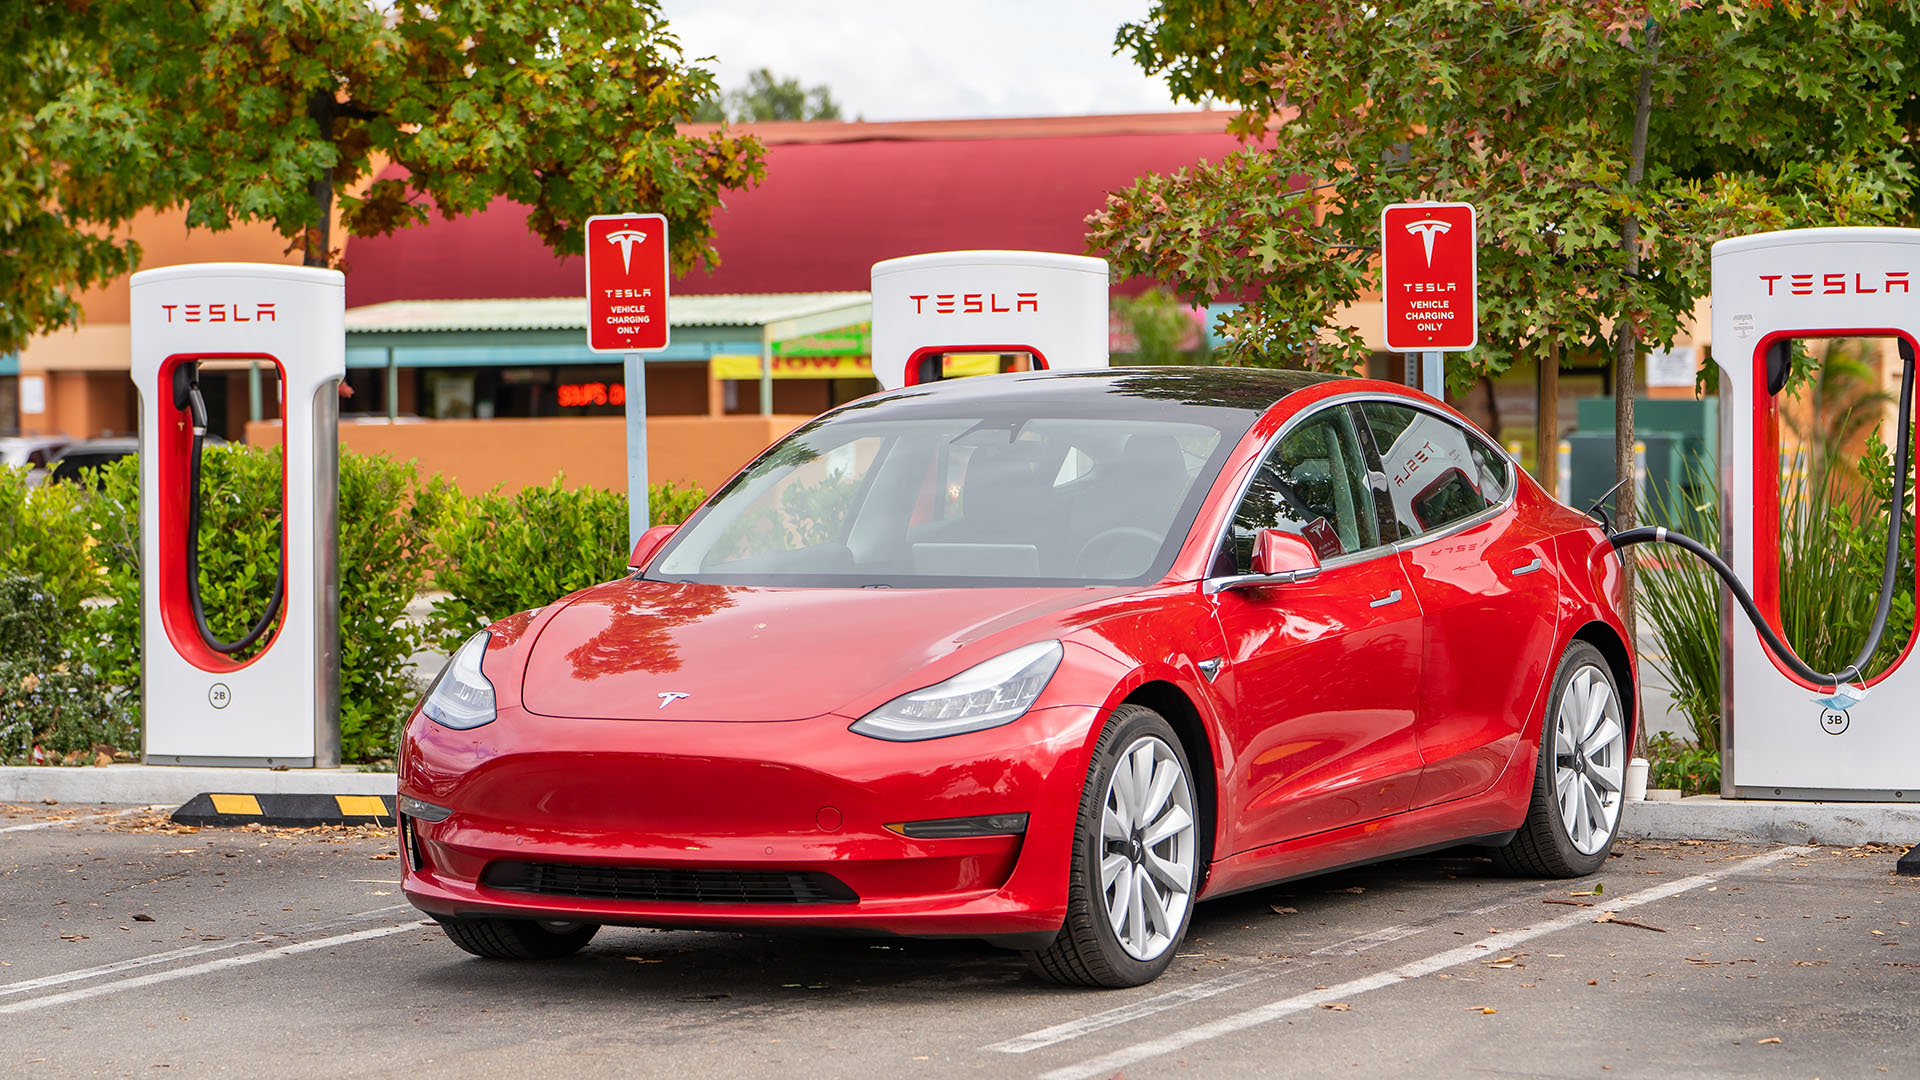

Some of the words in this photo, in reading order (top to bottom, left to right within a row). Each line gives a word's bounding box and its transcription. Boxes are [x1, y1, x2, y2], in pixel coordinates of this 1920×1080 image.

[1403, 282, 1456, 293] TESLA
[1760, 272, 1910, 296] TESLA
[604, 288, 652, 298] TESLA
[910, 293, 1037, 314] TESLA
[1409, 300, 1450, 309] VEHICLE
[162, 304, 275, 323] TESLA
[610, 305, 646, 313] VEHICLE
[607, 315, 650, 324] CHARGING
[1405, 311, 1455, 321] CHARGING
[616, 326, 641, 334] ONLY
[1416, 322, 1443, 332] ONLY
[213, 691, 226, 700] 2B
[1827, 715, 1843, 725] 3B
